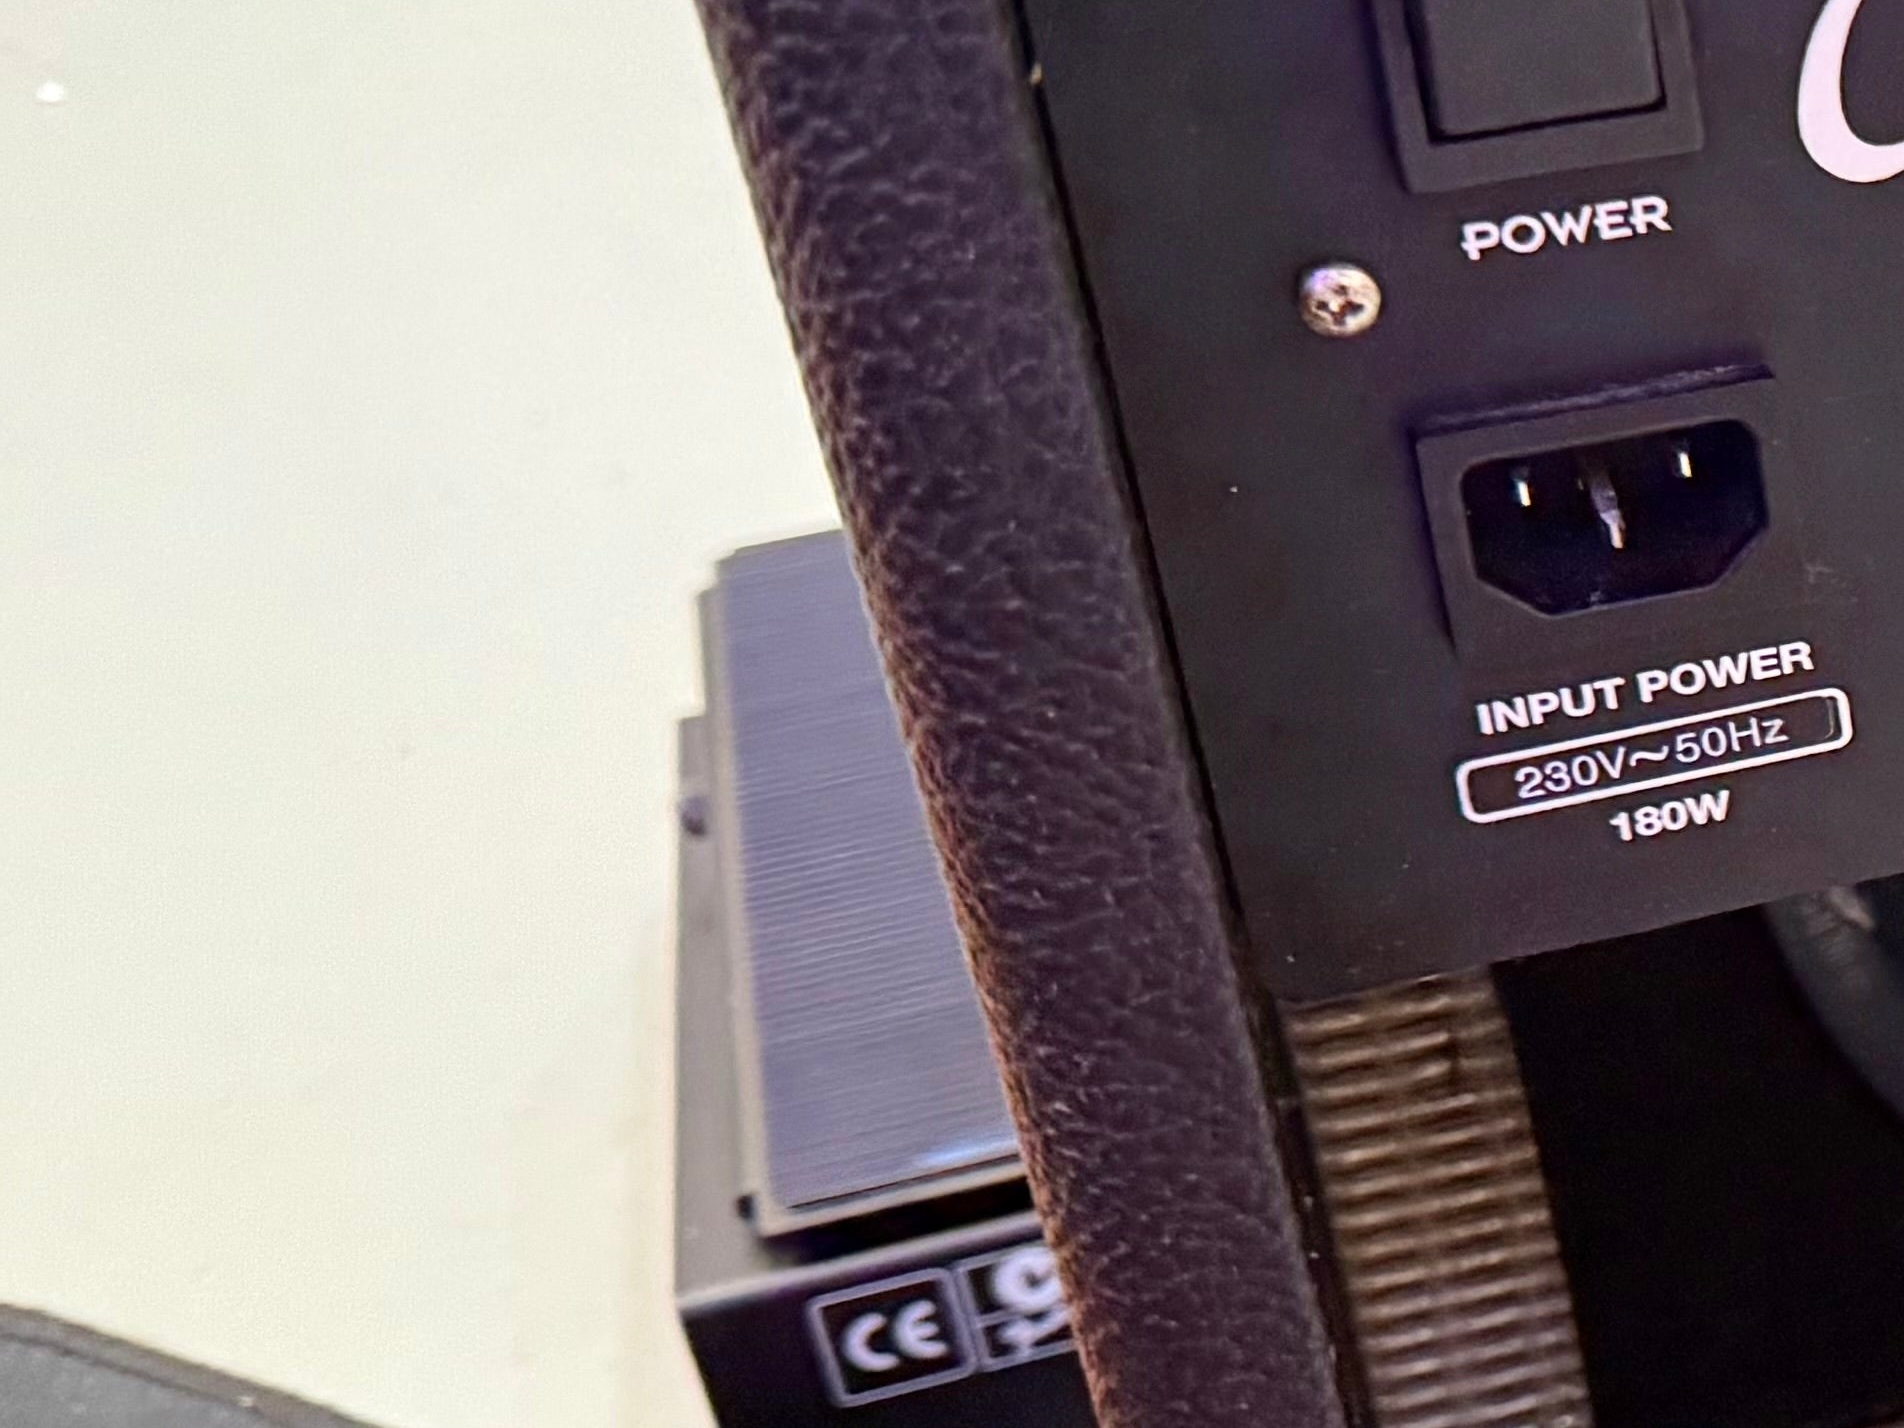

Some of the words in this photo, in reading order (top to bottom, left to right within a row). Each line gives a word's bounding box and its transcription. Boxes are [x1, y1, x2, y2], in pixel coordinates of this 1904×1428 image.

[1459, 194, 1673, 261] POWER
[1475, 675, 1626, 736] INPUT
[1634, 639, 1815, 704] POWER
[1607, 788, 1730, 842] 180W
[842, 1299, 949, 1372] CE
